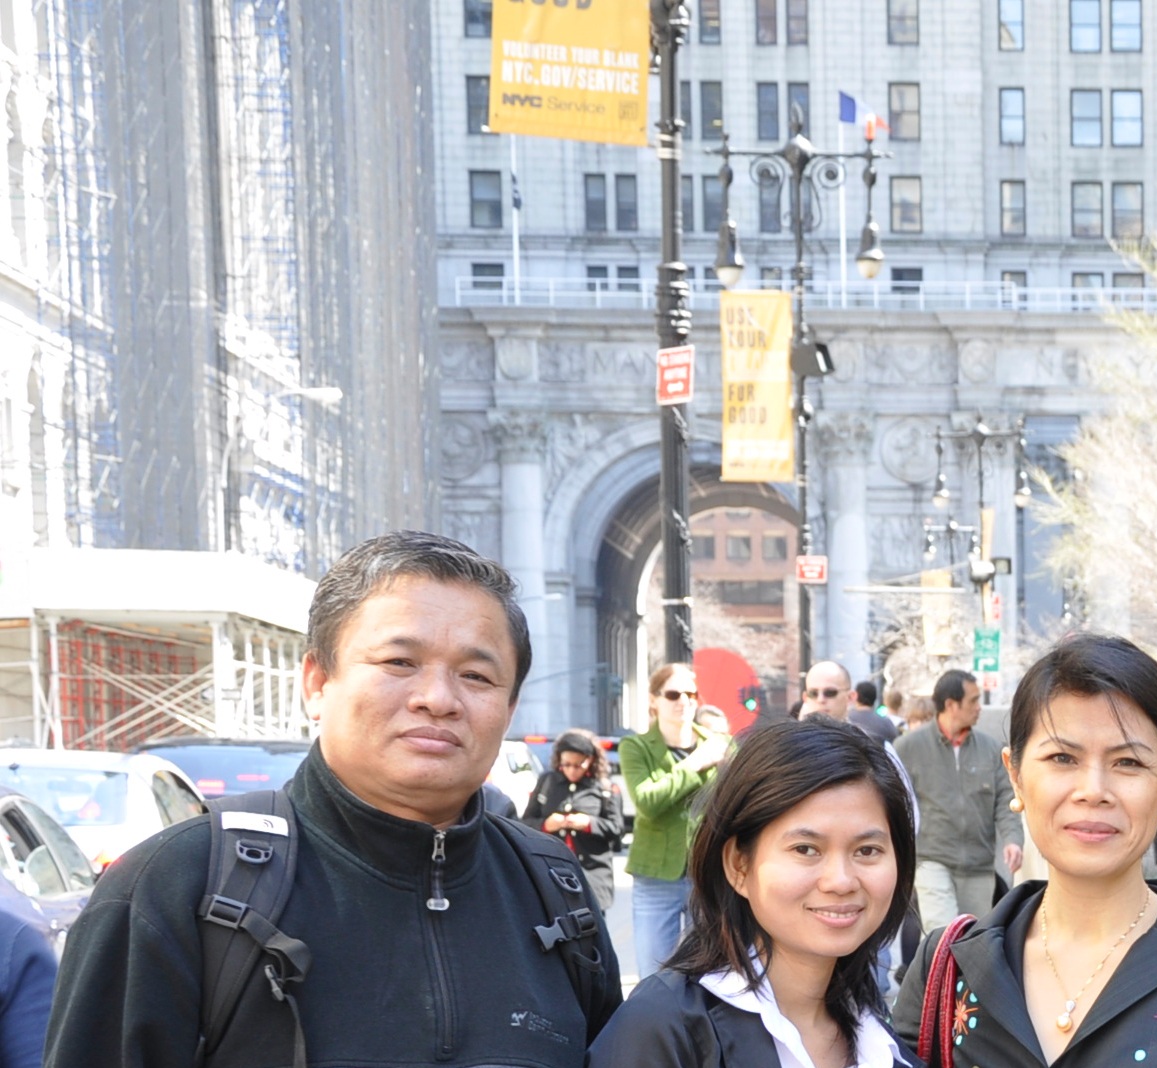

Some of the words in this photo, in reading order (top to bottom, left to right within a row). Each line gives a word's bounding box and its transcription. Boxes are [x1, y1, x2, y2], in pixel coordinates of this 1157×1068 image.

[502, 39, 568, 63] VOLUNTEER
[570, 45, 600, 65] YOUR
[602, 48, 640, 69] BLANK
[501, 60, 640, 95] NYC.GOV/SERVICE
[501, 92, 543, 109] NYC
[546, 96, 606, 114] Service
[726, 306, 752, 326] USE
[728, 328, 767, 348] YOUR
[728, 382, 755, 402] FOR
[728, 405, 767, 425] GOOD
